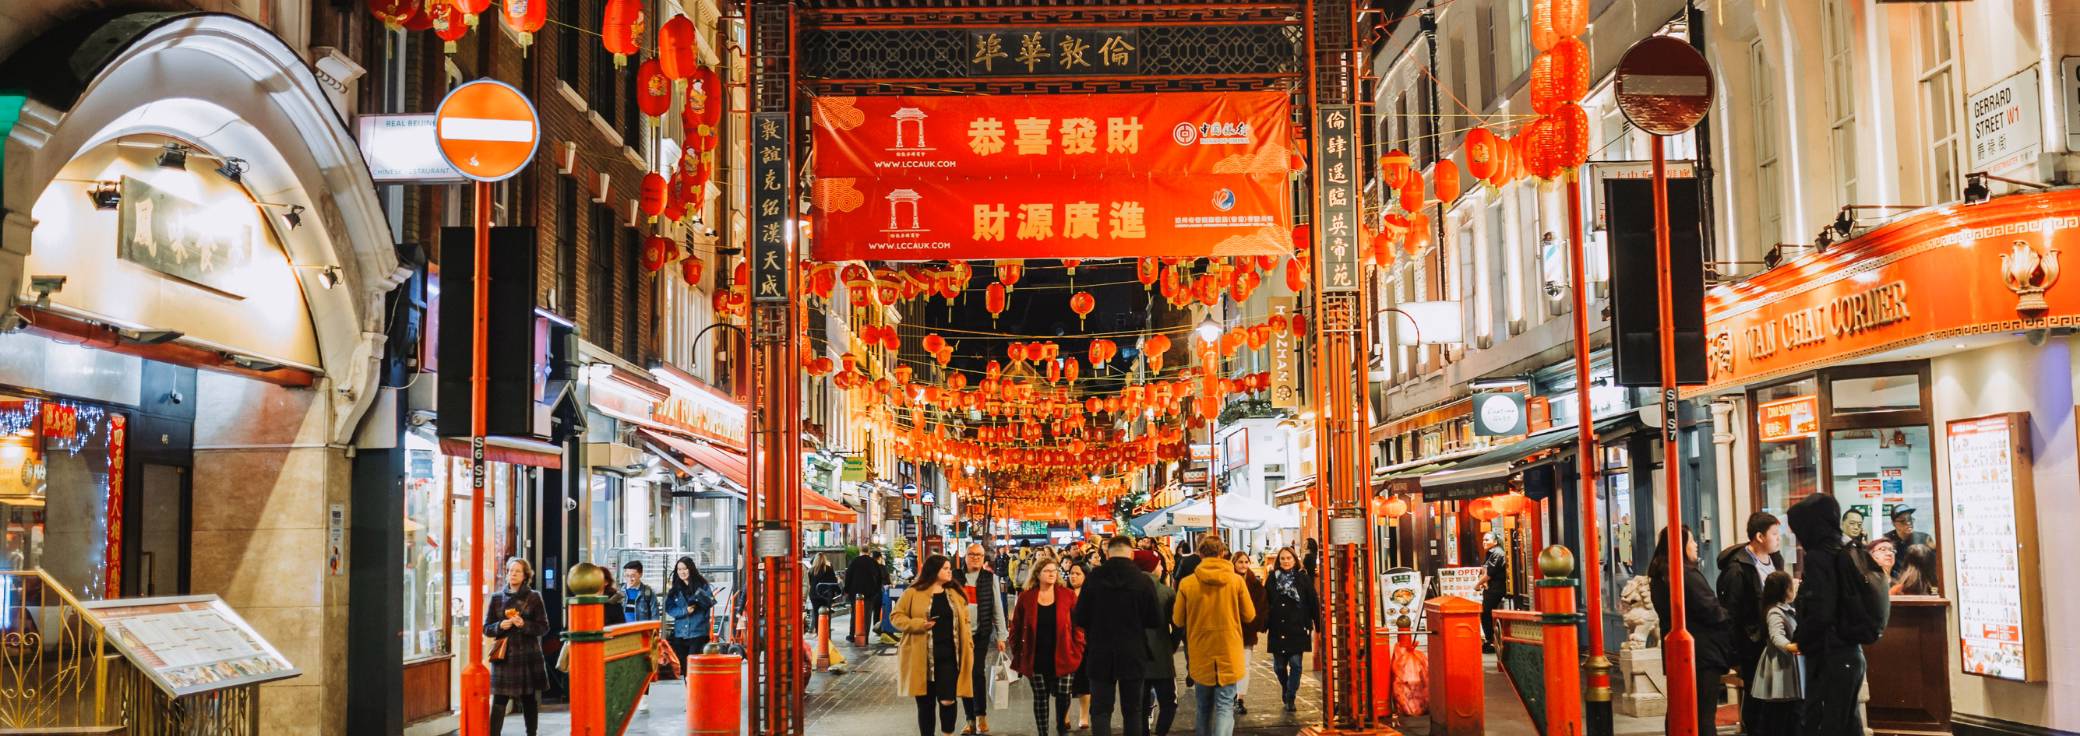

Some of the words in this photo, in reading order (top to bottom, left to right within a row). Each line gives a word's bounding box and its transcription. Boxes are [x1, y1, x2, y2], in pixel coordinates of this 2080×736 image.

[1974, 87, 2012, 119] GERRARD
[967, 116, 1144, 155] 恭喜發財
[1975, 111, 2004, 139] STREET
[2006, 105, 2020, 126] W1
[404, 167, 450, 175] ESTAURANT
[873, 160, 956, 168] WWW.LCCAUK.COM
[972, 201, 1147, 241] 財源廣進
[868, 242, 951, 250] WWW.LCCAUK.COM
[1742, 319, 1777, 361] WAN
[1781, 303, 1826, 350] CHAI
[1829, 279, 1911, 337] CORNER
[1767, 406, 1779, 418] DIM
